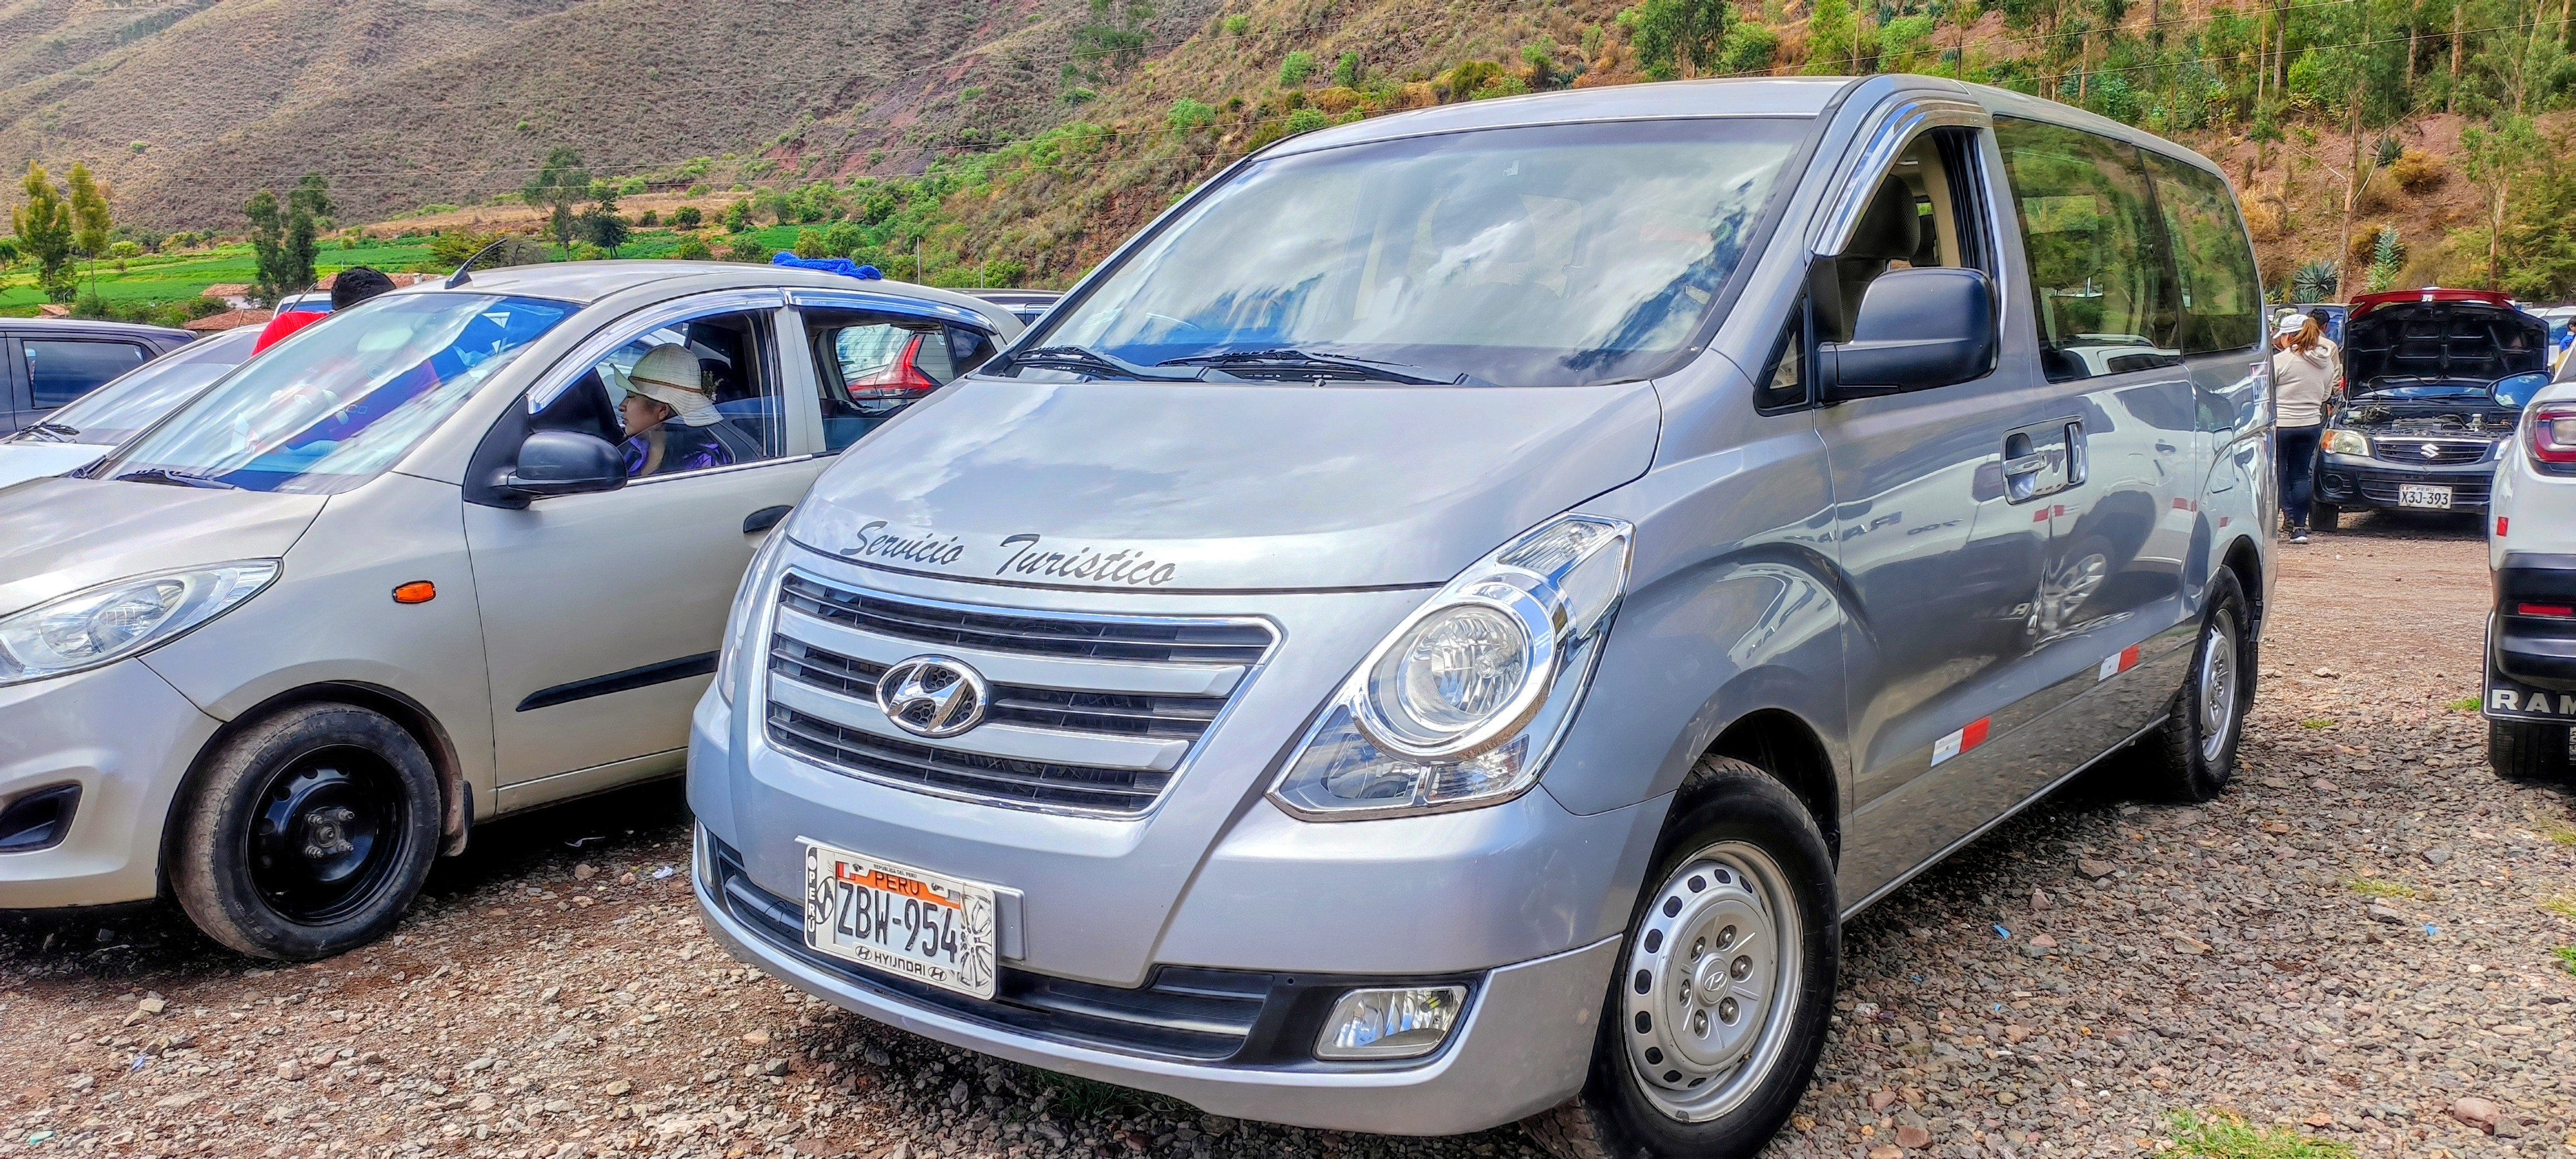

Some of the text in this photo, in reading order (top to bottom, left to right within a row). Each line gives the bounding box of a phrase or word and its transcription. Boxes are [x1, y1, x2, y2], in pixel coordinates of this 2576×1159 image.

[2401, 491, 2449, 505] X3J-393
[840, 520, 1176, 586] Servicio Turistico
[2491, 689, 2576, 715] RAM
[875, 870, 919, 895] PERU
[807, 871, 816, 933] PERÚ
[837, 881, 958, 964] ZBW-954
[874, 951, 925, 976] HYUNDAI
